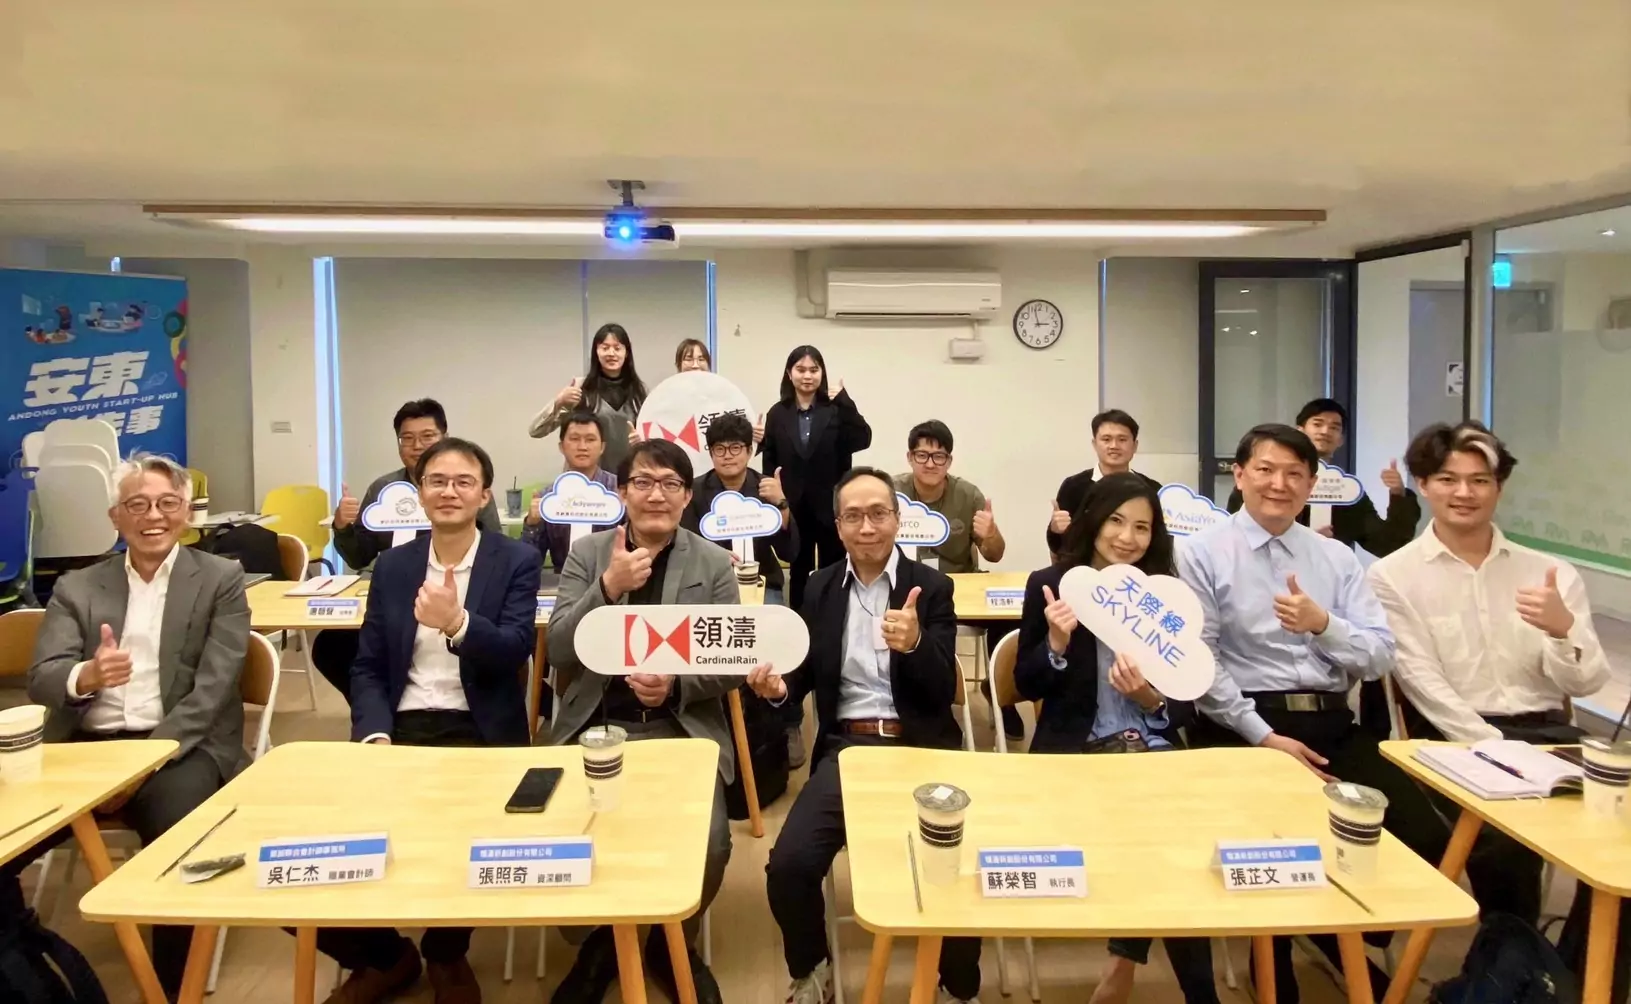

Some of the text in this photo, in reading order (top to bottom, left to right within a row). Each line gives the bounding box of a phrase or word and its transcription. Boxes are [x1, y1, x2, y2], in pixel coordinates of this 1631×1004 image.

[23, 351, 149, 407] 安東
[8, 391, 178, 421] ANDONG YOUTH START-UP HUB
[1115, 575, 1186, 637] 天際線
[693, 616, 757, 649] 領濤
[1091, 585, 1186, 668] SKYLINE
[695, 655, 758, 665] CardinalRain
[267, 864, 320, 885] 吳仁杰
[479, 866, 528, 885] 張照奇
[987, 871, 1037, 890] 蘇榮智
[1230, 866, 1280, 886] 張芷文
